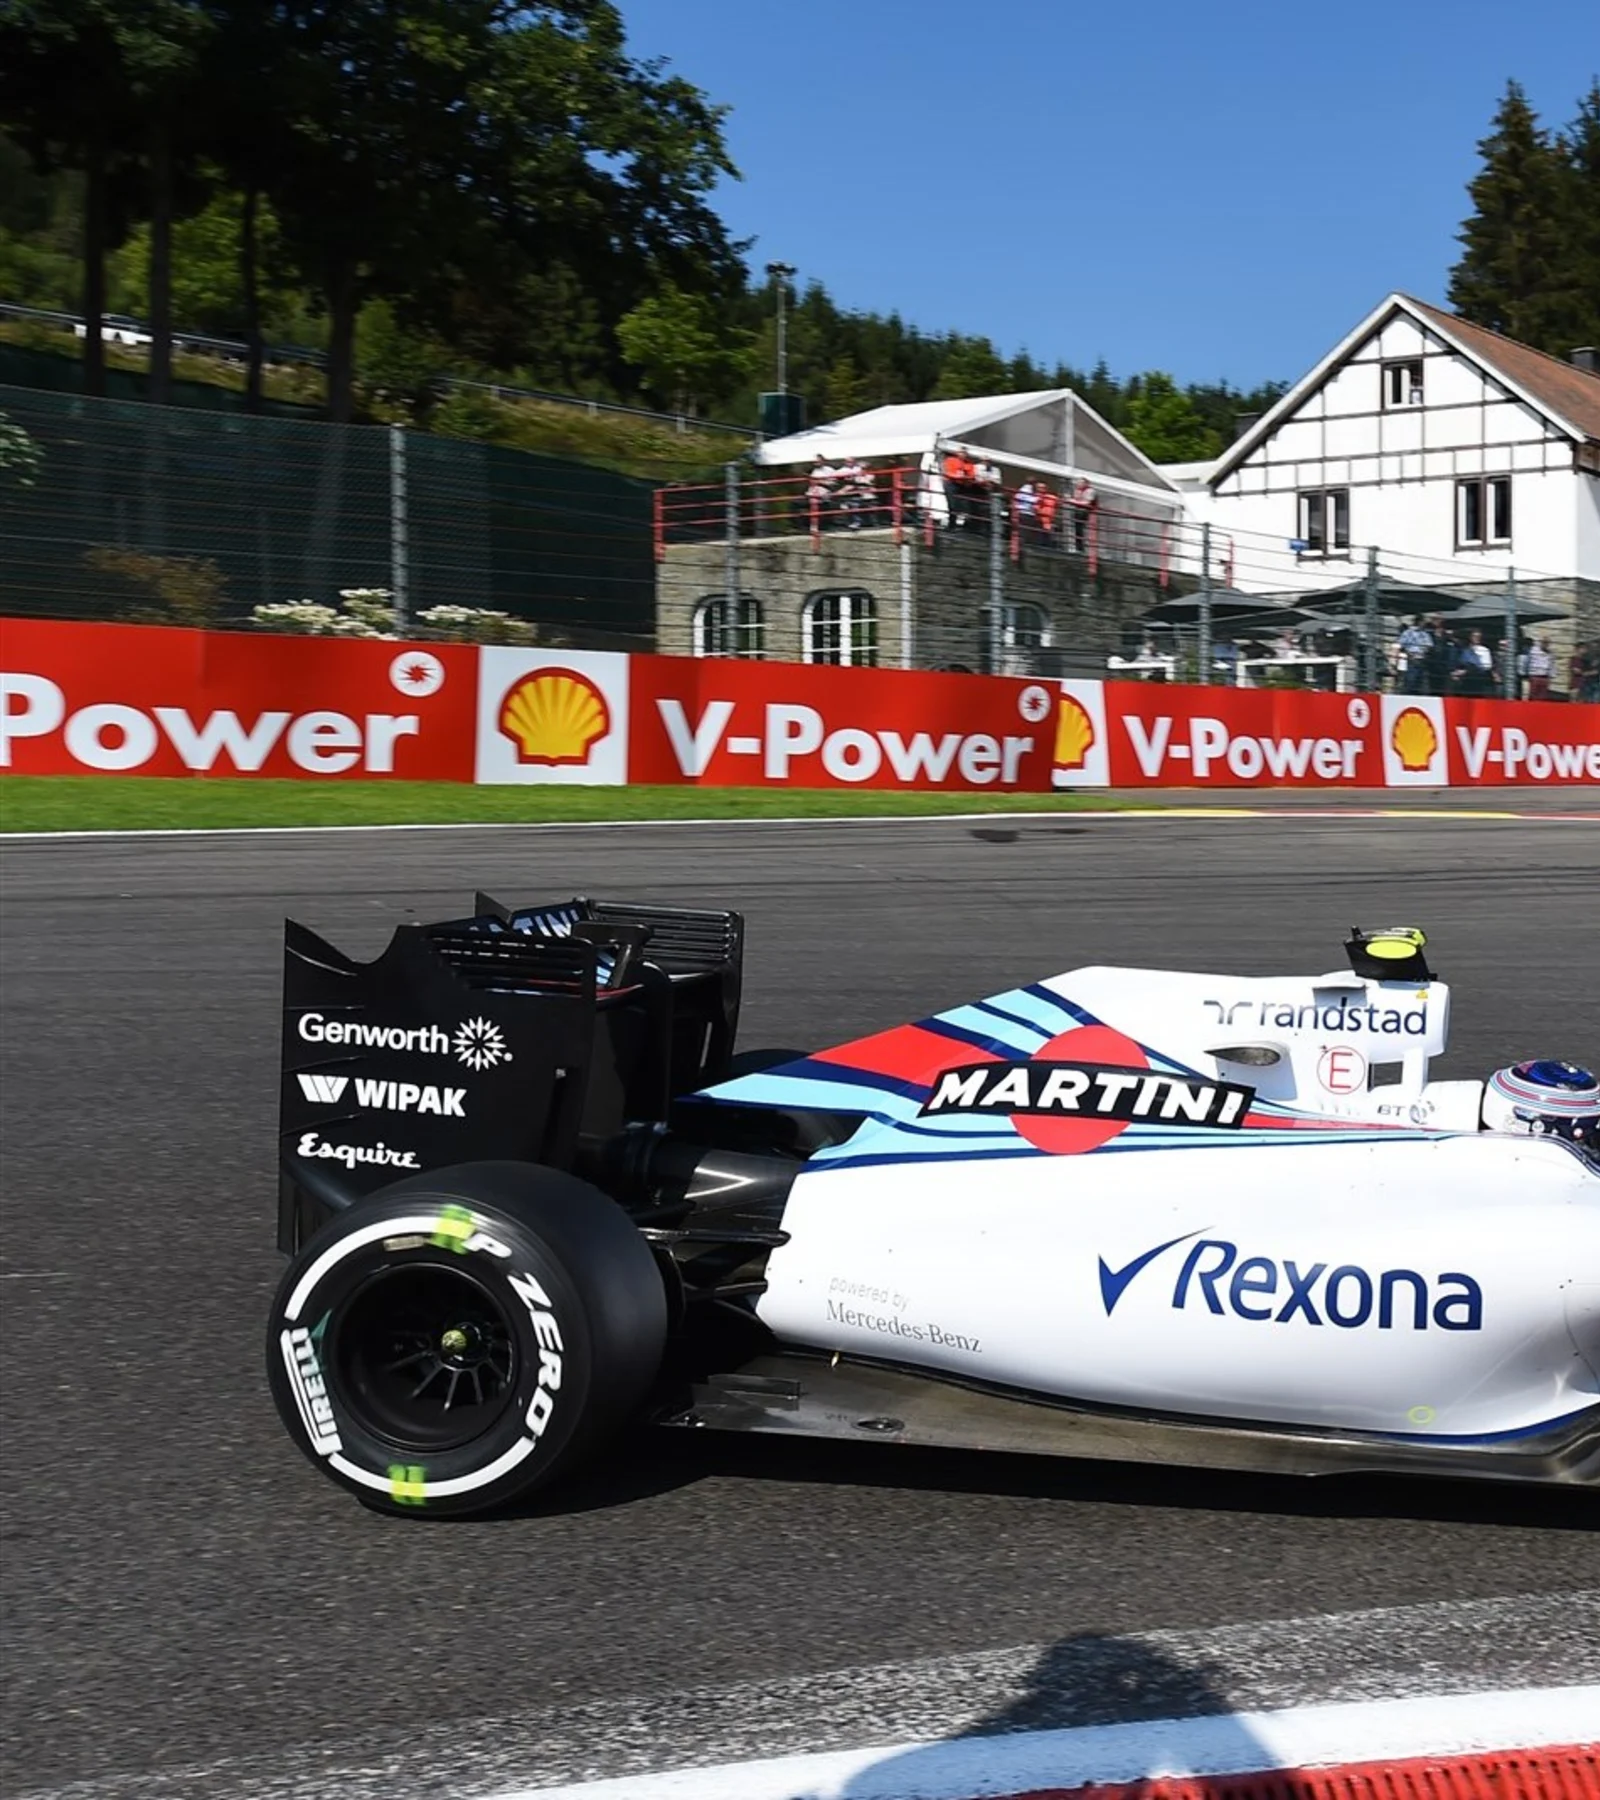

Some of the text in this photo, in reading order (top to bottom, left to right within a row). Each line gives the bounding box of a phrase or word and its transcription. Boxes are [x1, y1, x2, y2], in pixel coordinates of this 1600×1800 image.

[656, 699, 1034, 785] V-Power
[1122, 715, 1365, 780] V-Power
[298, 1012, 450, 1055] Genworth
[1259, 996, 1429, 1035] randstad
[354, 1077, 468, 1118] WIPAK
[928, 1067, 1245, 1125] MARTINI
[1329, 1051, 1353, 1088] E
[296, 1132, 422, 1170] Esquire
[829, 1276, 889, 1304] powered
[1171, 1239, 1484, 1331] Rexona
[826, 1298, 983, 1354] Mercedes-Benz
[507, 1271, 564, 1438] ZERO
[280, 1326, 344, 1456] PIRELLI
